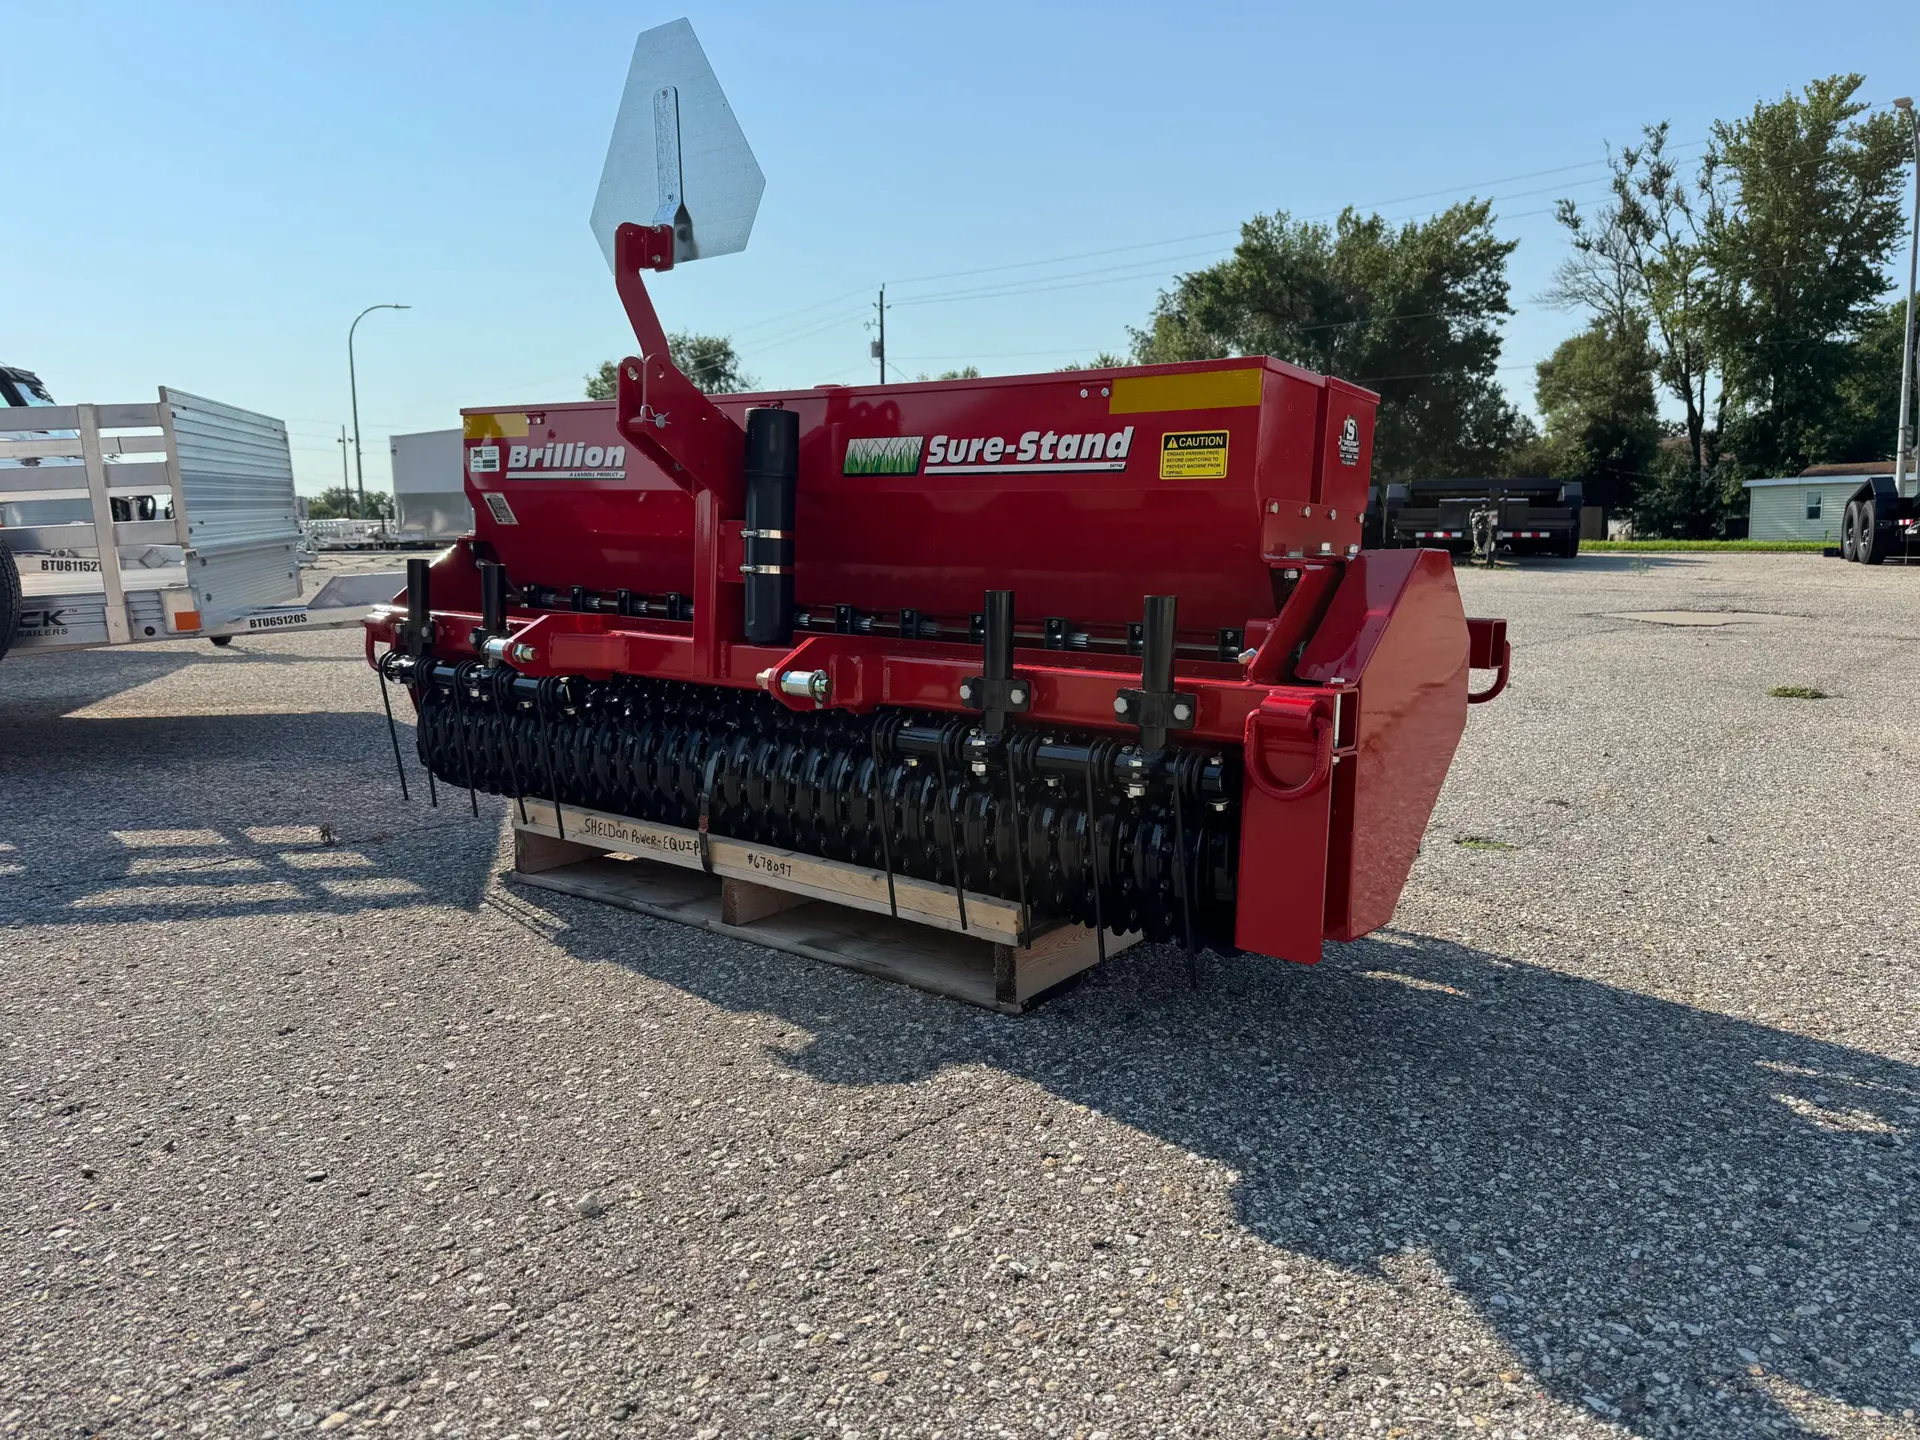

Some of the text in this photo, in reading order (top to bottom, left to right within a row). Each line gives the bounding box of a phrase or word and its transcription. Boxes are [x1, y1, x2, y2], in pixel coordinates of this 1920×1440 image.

[926, 426, 1135, 464] Sure-Stand
[1179, 436, 1224, 447] CAUTION
[507, 442, 626, 469] Brillion
[250, 613, 308, 628] BTU65120S
[747, 853, 792, 877] #678097
